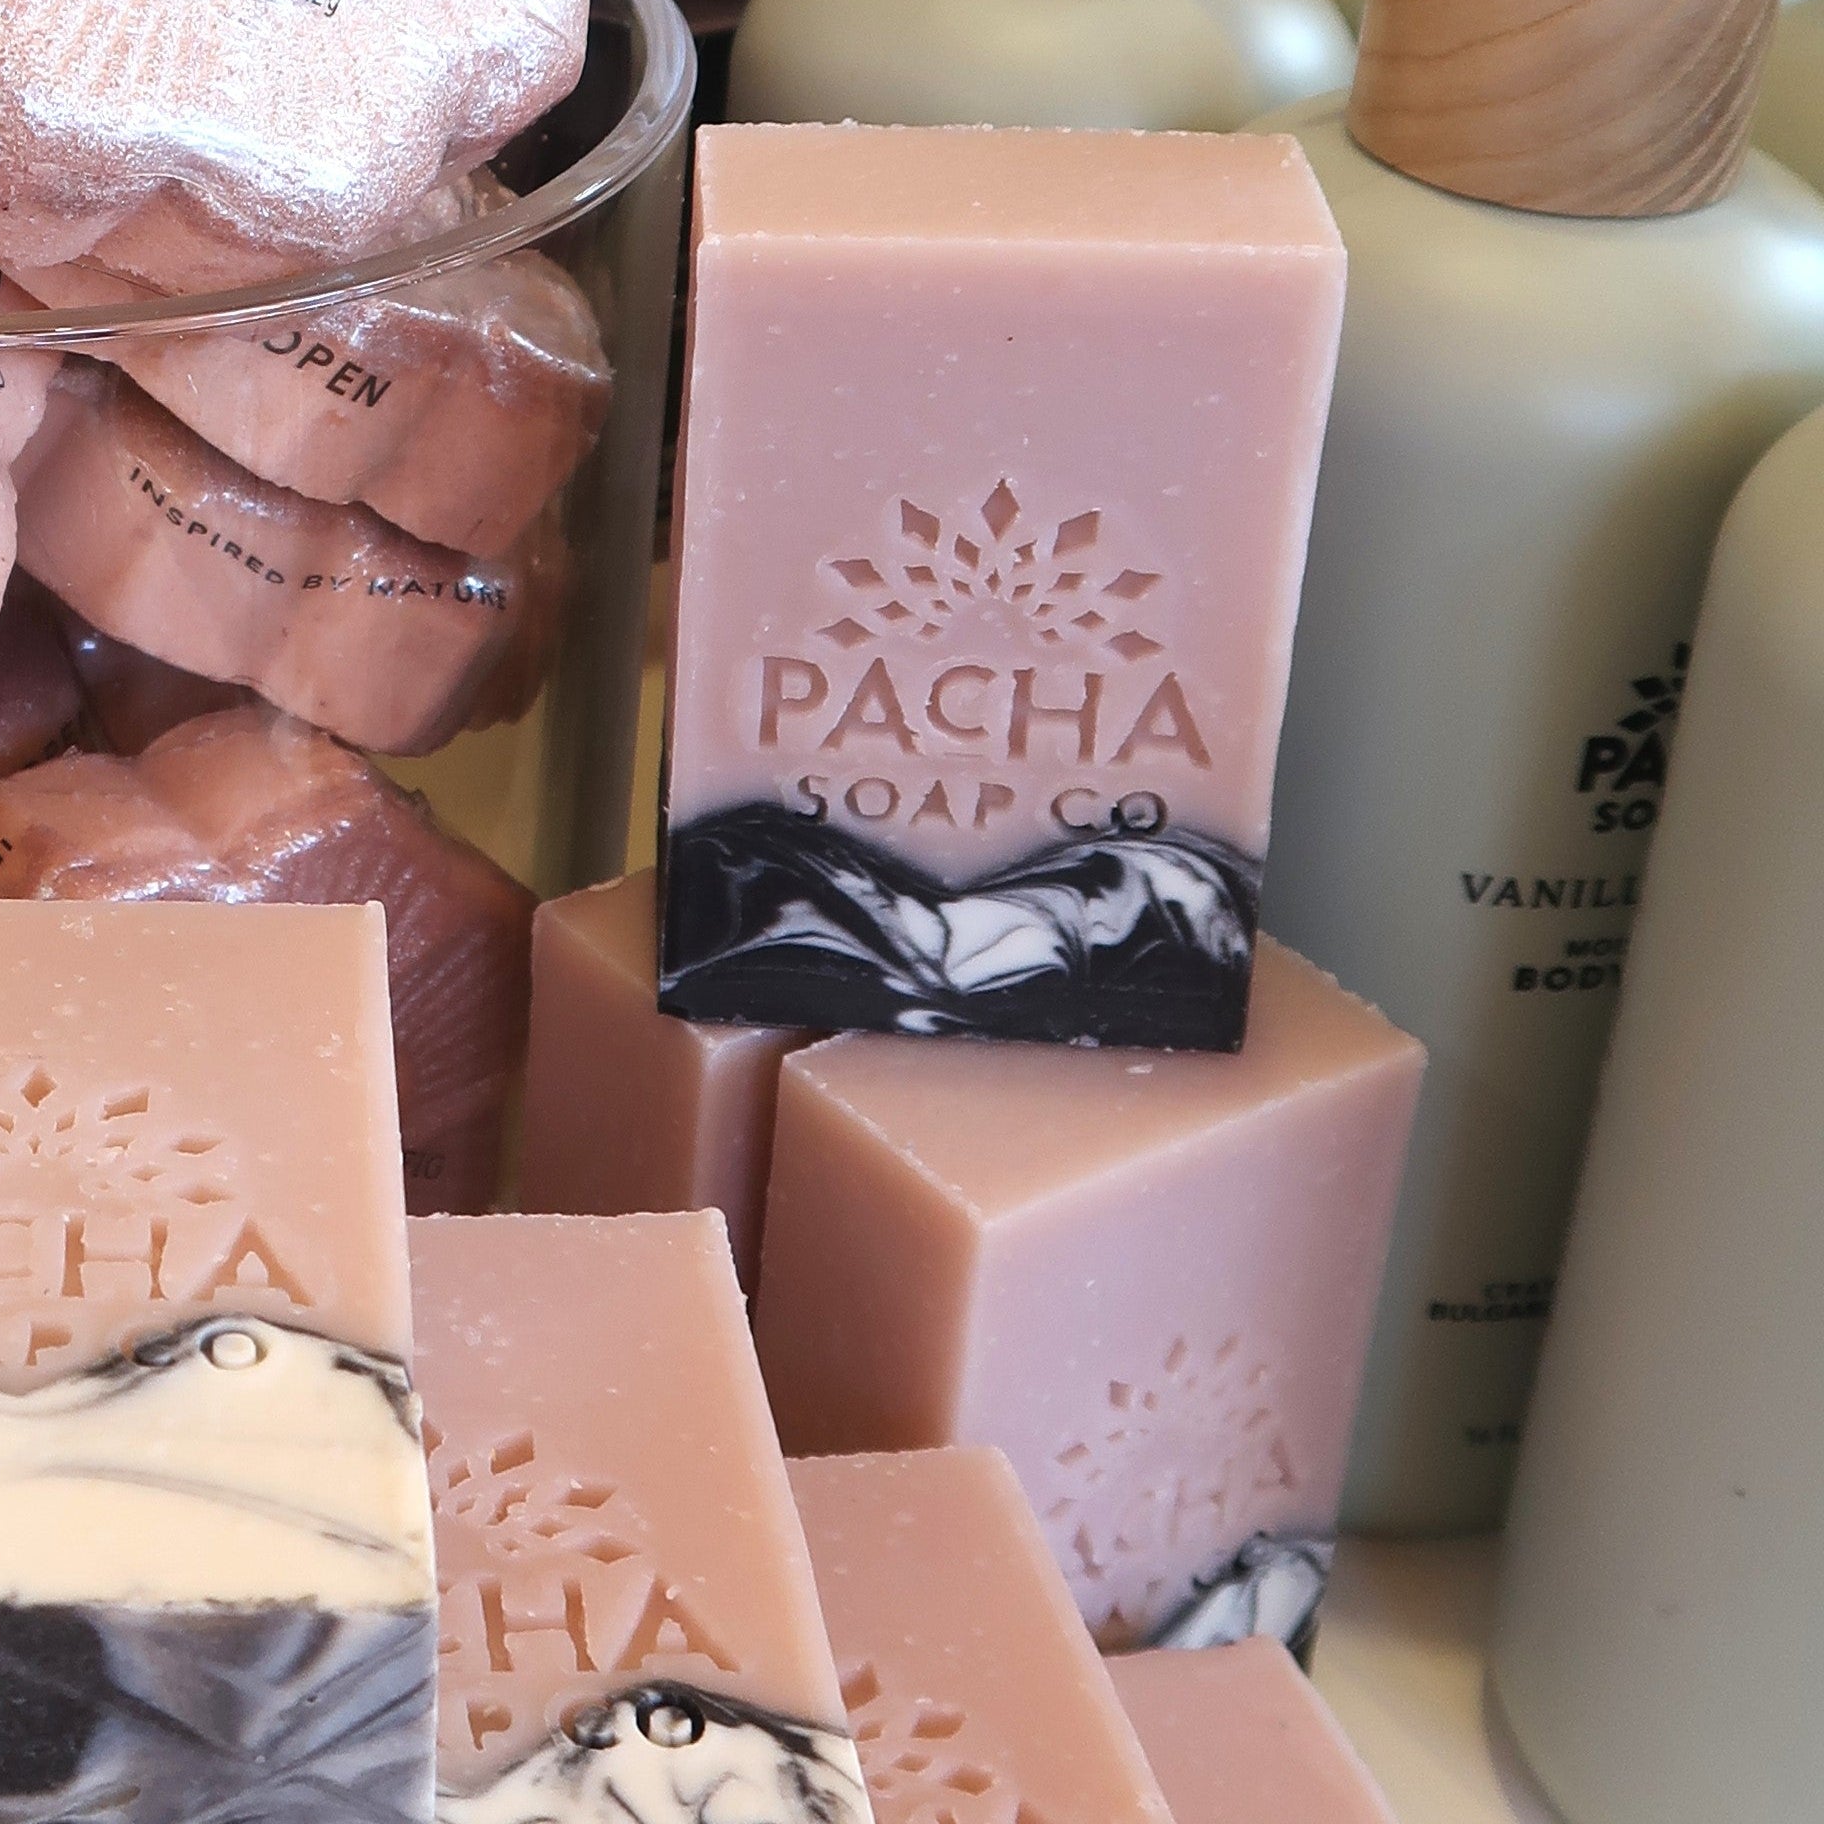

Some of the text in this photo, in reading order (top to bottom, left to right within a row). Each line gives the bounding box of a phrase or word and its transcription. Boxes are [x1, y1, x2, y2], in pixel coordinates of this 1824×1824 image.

[262, 328, 392, 409] OPEN
[128, 466, 509, 612] INSPIRED BY NATURE
[757, 655, 1214, 771] PACHA
[795, 774, 1169, 836] SOAP CO
[1460, 873, 1640, 911] VANILL
[1512, 963, 1622, 992] BOD
